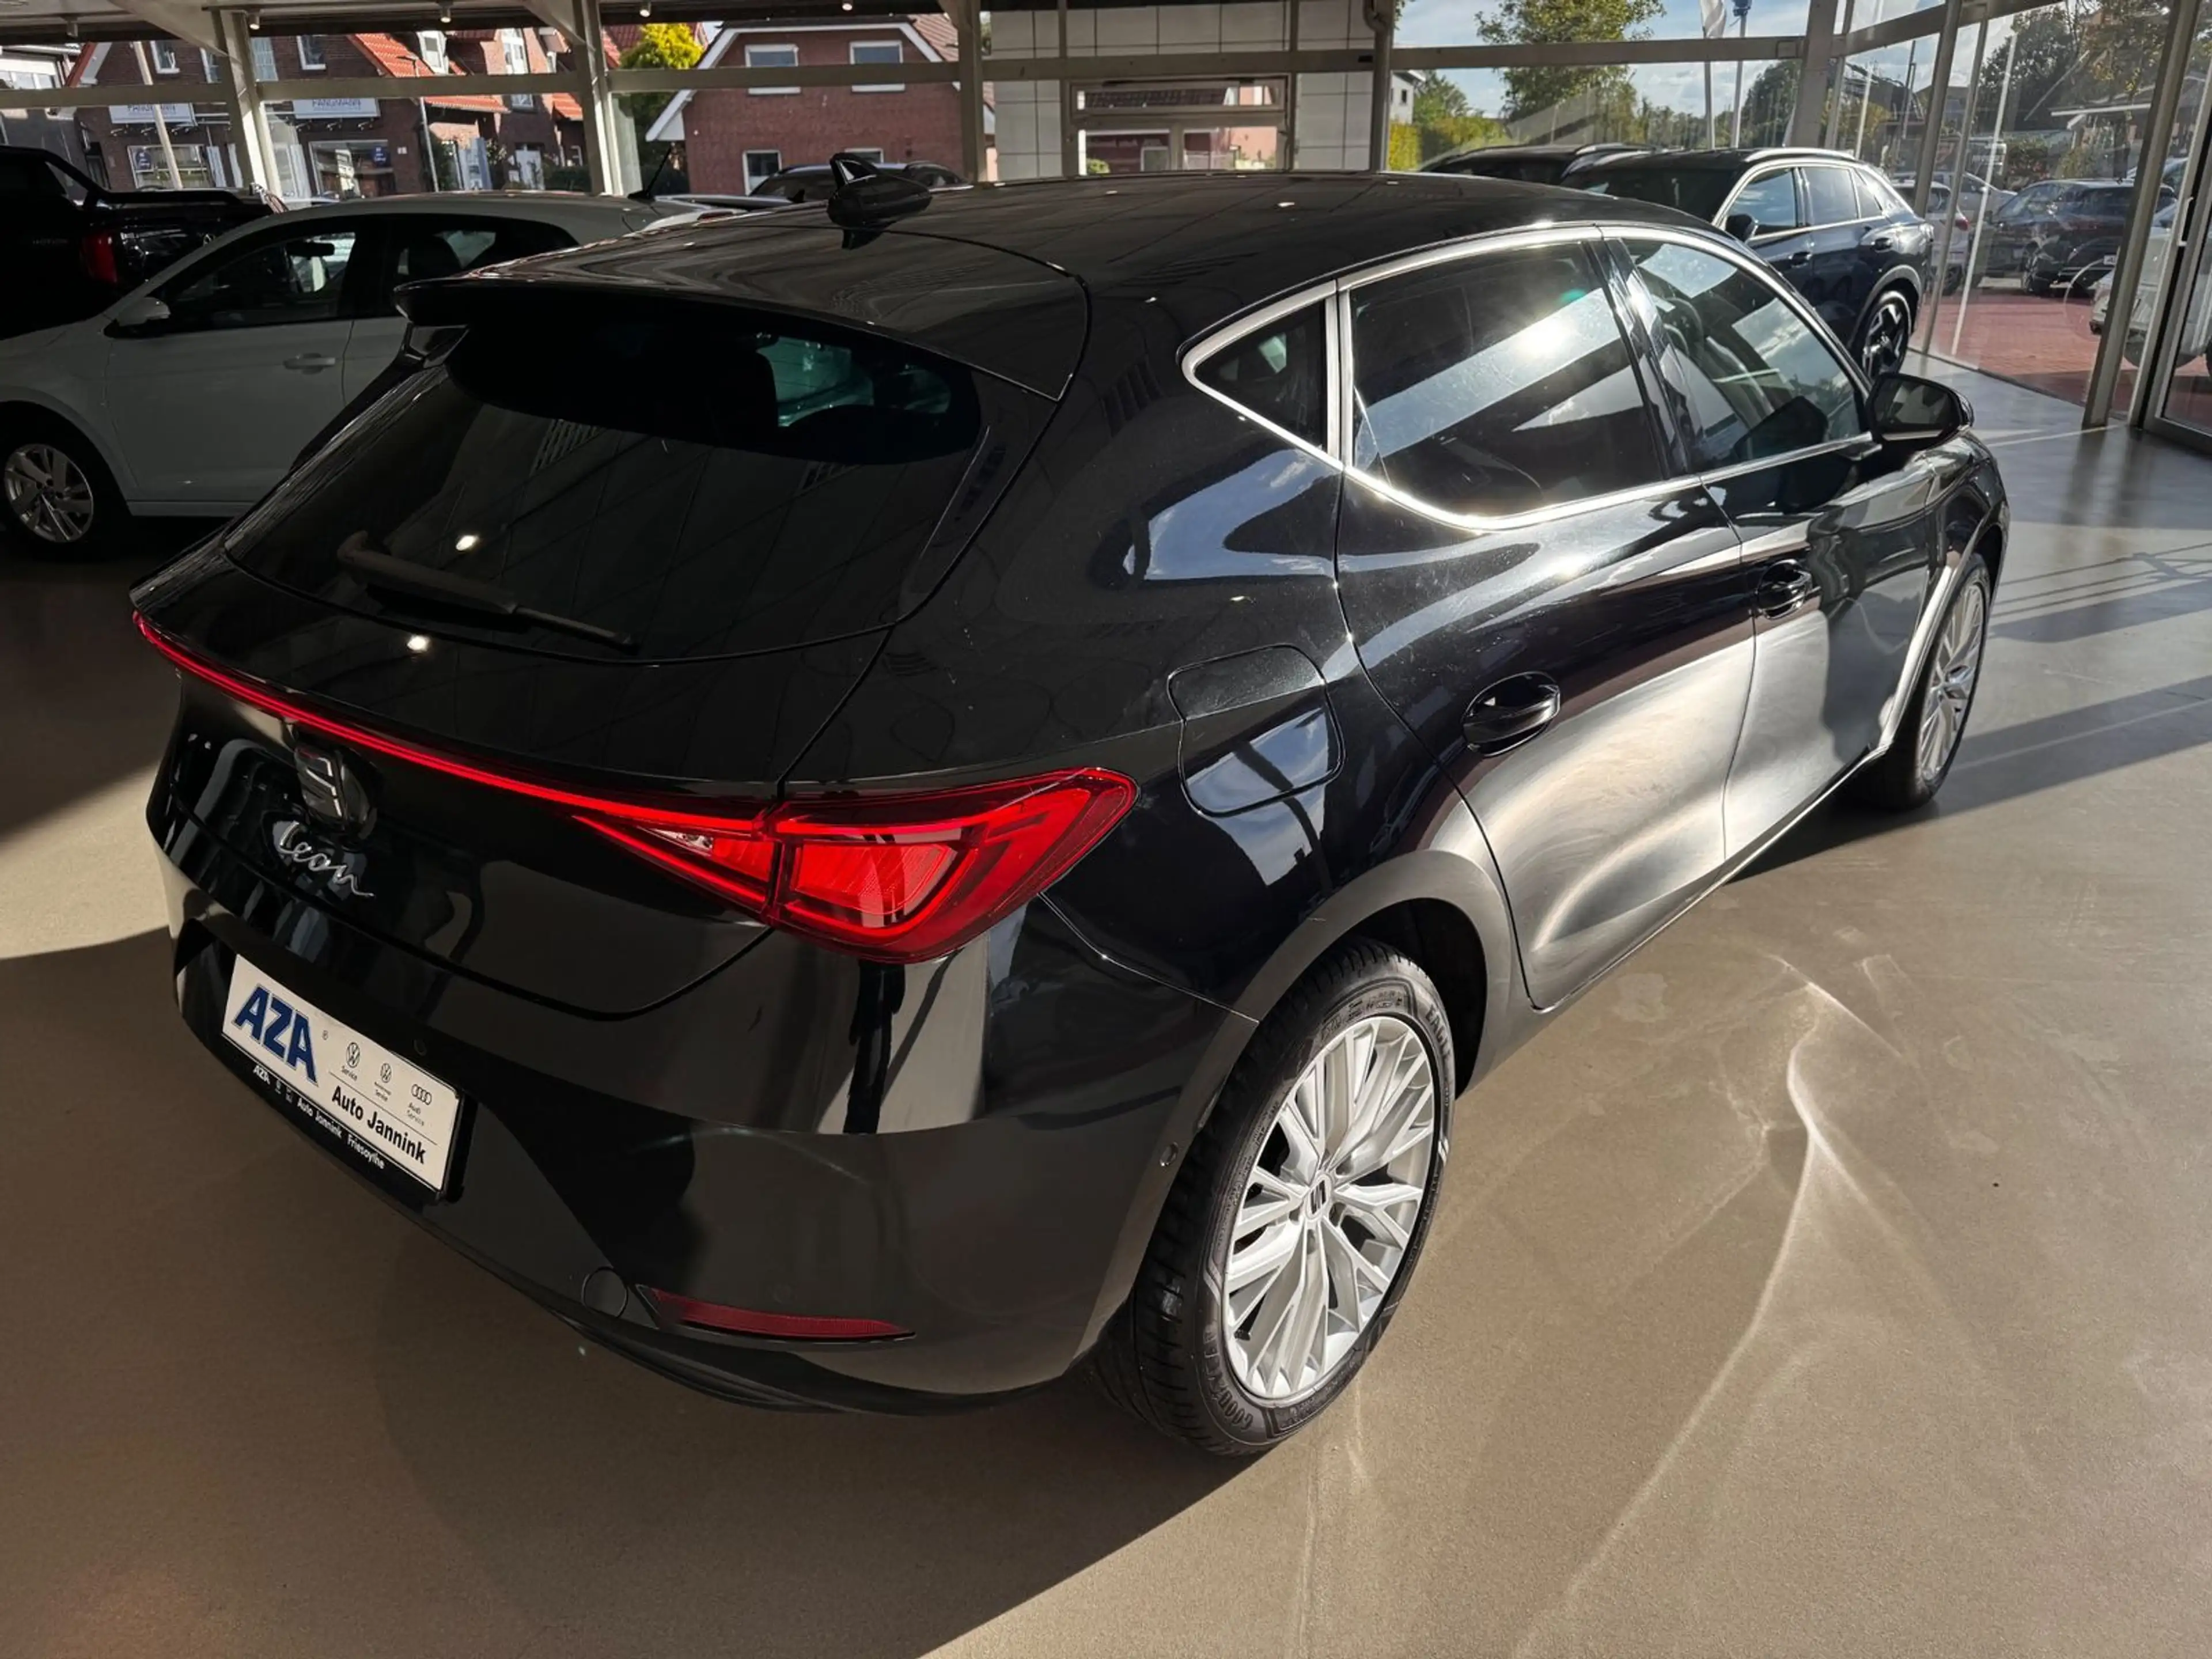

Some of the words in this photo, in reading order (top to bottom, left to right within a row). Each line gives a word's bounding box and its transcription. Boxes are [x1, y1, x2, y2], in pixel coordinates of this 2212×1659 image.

[280, 820, 374, 897] Leon
[232, 983, 319, 1088] AZA
[1425, 1004, 1450, 1056] EAGLE
[253, 1065, 271, 1085] AZA
[297, 1097, 313, 1117] Auto
[315, 1110, 343, 1139] Jannink
[332, 1085, 363, 1120] Auto
[367, 1111, 426, 1164] Jannink
